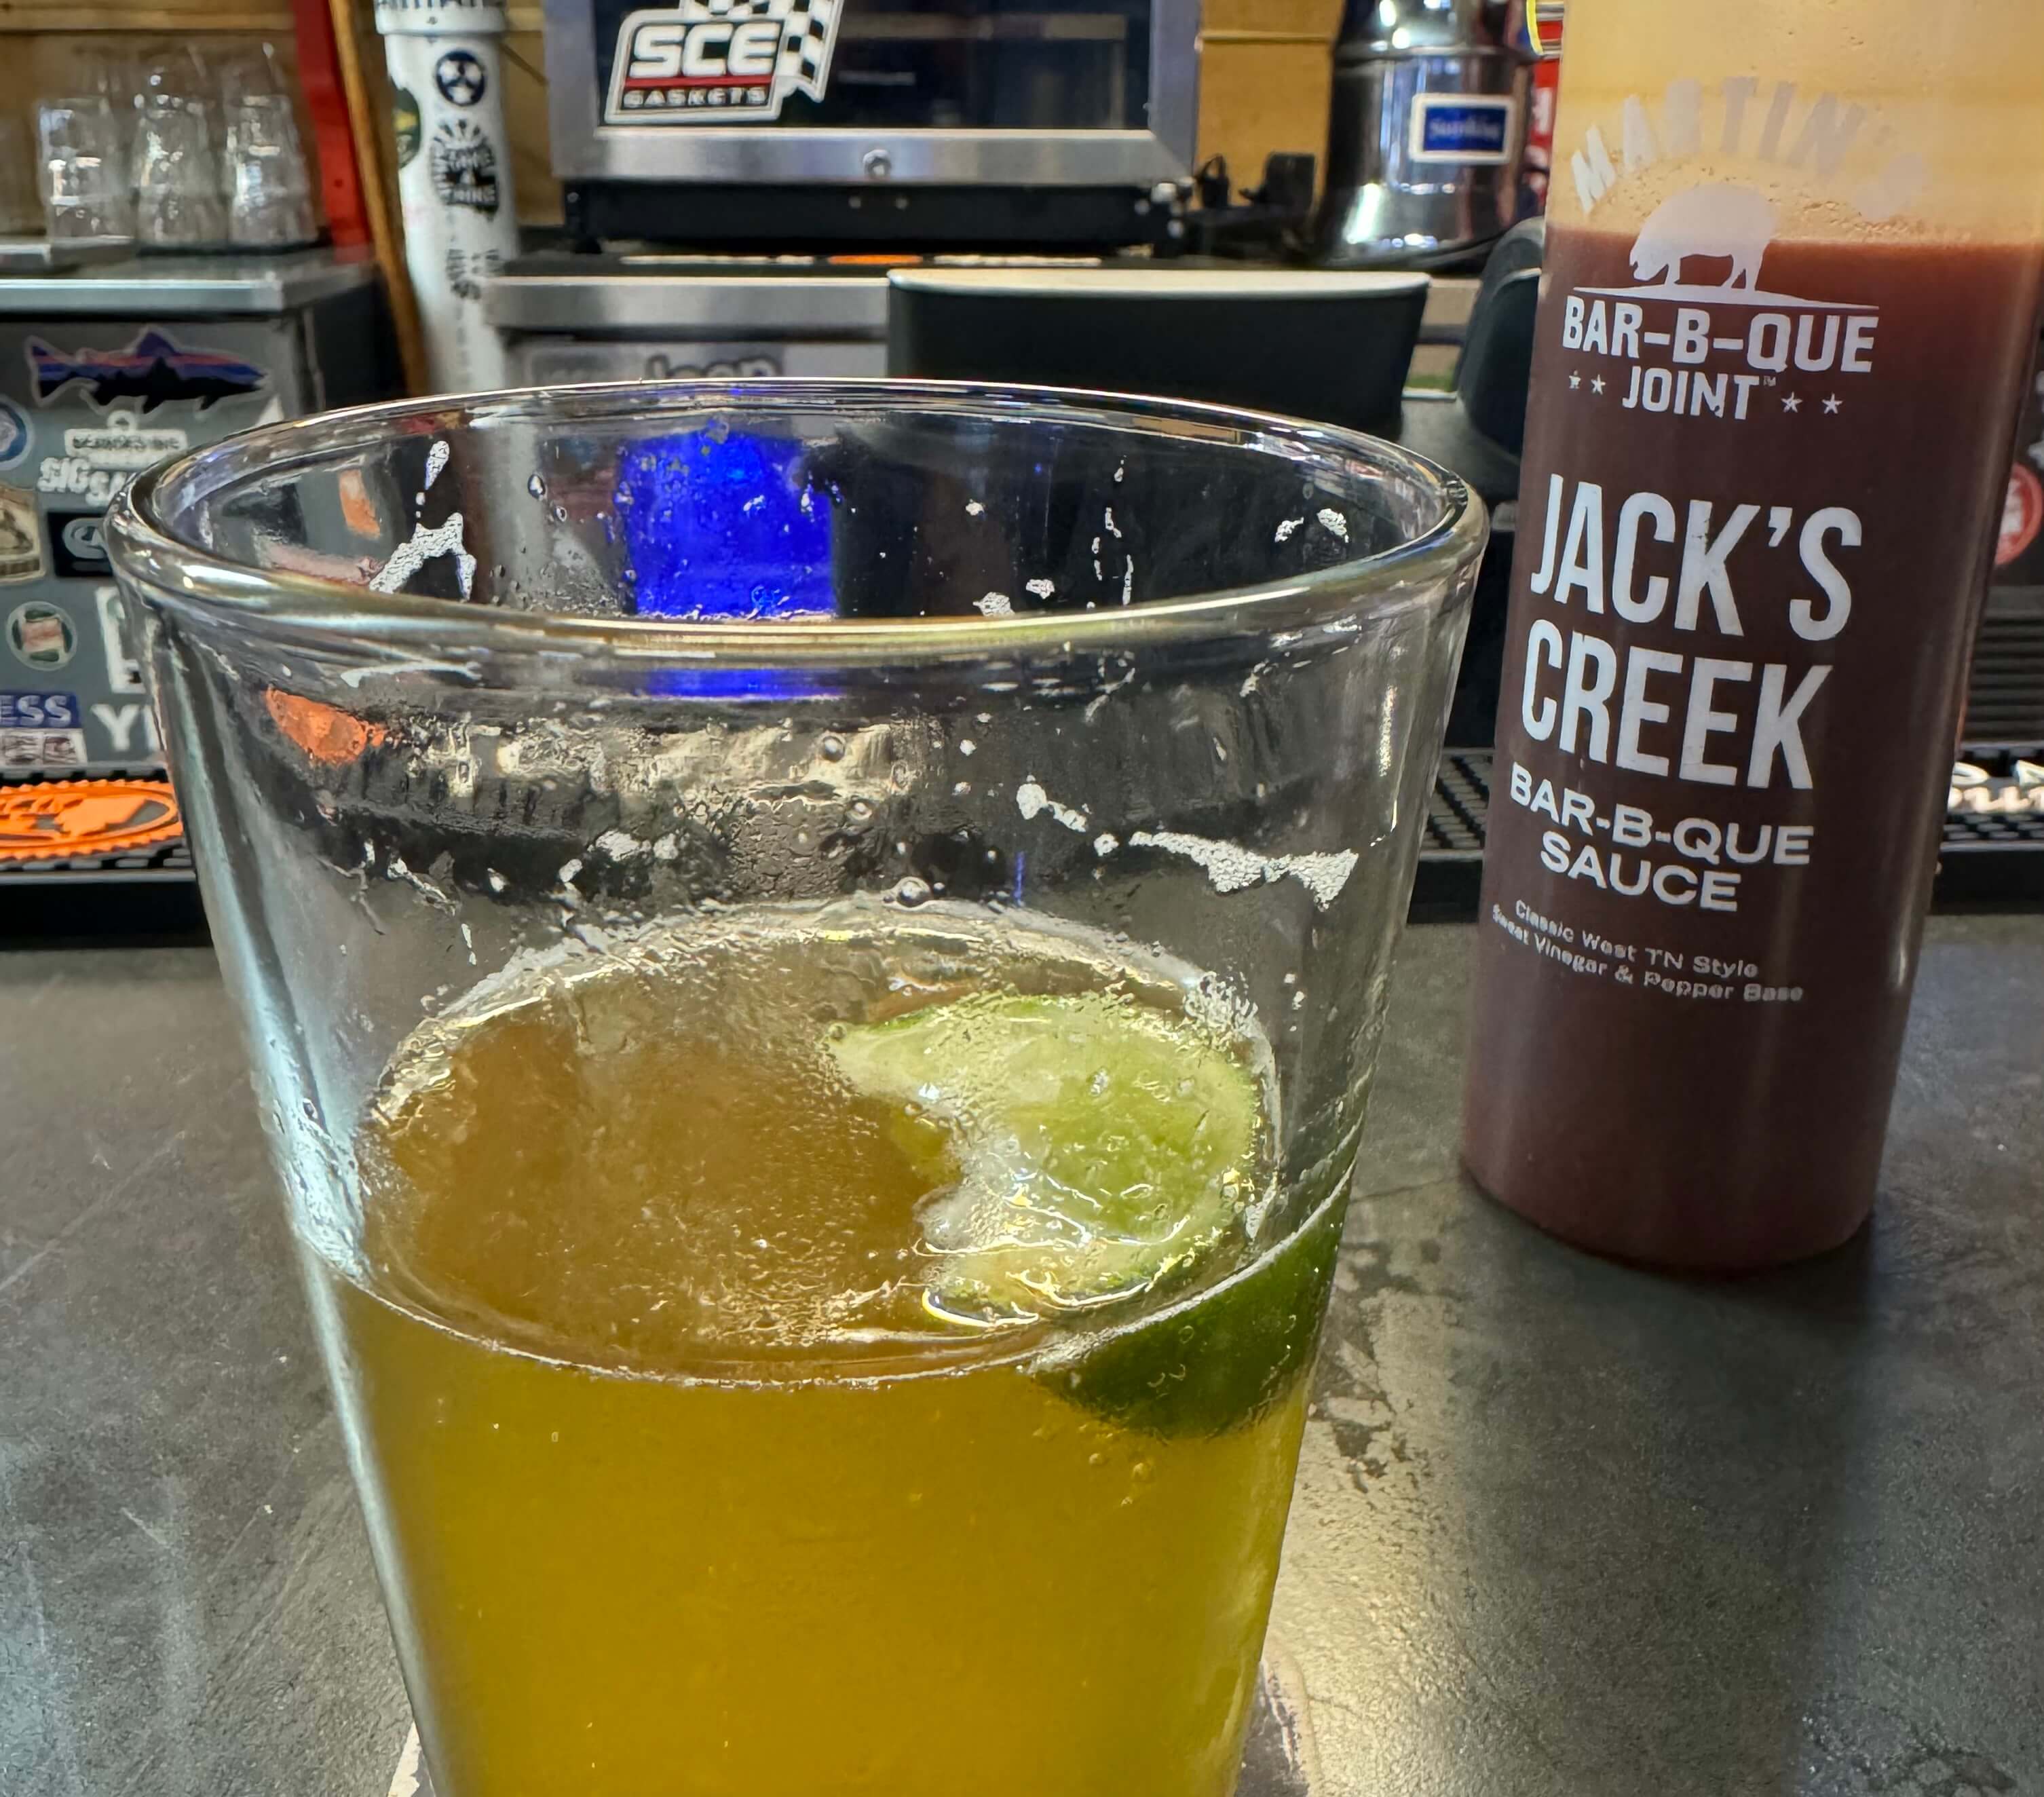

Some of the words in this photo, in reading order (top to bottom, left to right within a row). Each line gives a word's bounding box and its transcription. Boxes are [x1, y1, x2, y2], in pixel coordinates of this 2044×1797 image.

[630, 22, 781, 78] SCE
[624, 86, 768, 108] GASKETS
[1562, 295, 1879, 373] BAR-B-QUE
[1530, 473, 1862, 641] JACK'S
[1521, 618, 1833, 789] CREEK
[1510, 761, 1814, 865] BAR-B-QUE
[1540, 830, 1741, 911] SAUCE
[1515, 899, 1574, 943] Classic
[1583, 930, 1637, 962] West
[1644, 947, 1684, 970] TN
[1692, 955, 1759, 978] Style
[1534, 932, 1608, 975] Vinegar
[1614, 964, 1633, 985] &
[1644, 971, 1735, 1000] Pepper
[1743, 983, 1803, 1002] Base
